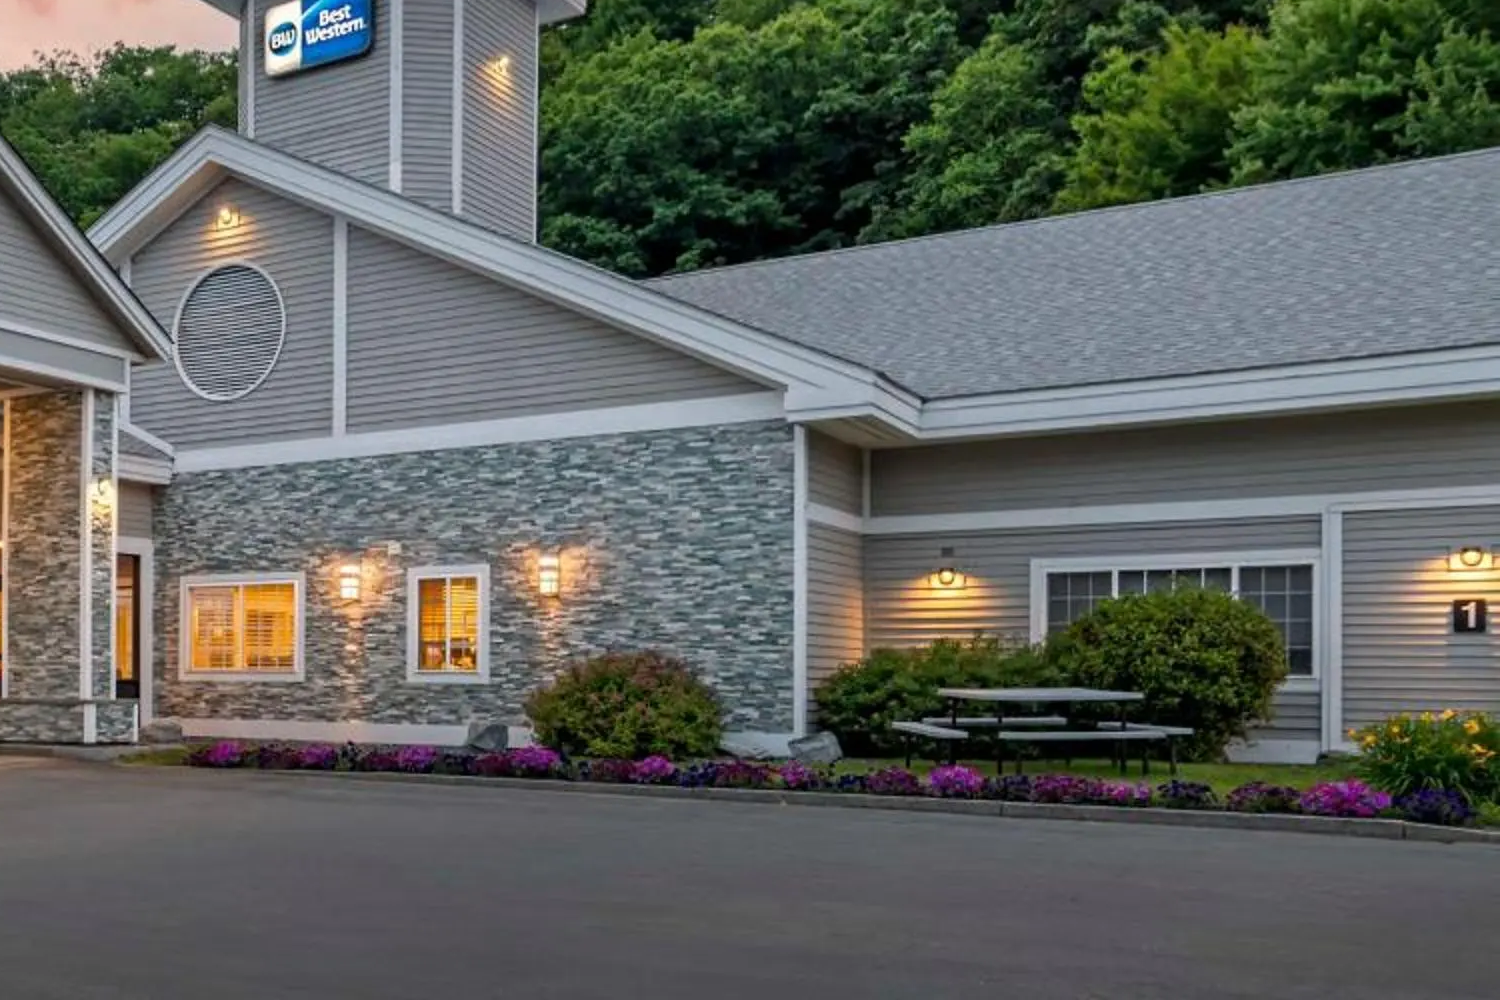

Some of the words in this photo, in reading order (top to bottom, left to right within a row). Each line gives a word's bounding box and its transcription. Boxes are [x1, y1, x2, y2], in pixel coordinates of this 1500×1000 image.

[319, 4, 351, 26] Best
[270, 28, 295, 49] BW
[305, 17, 364, 45] Western
[1461, 601, 1477, 629] 1
